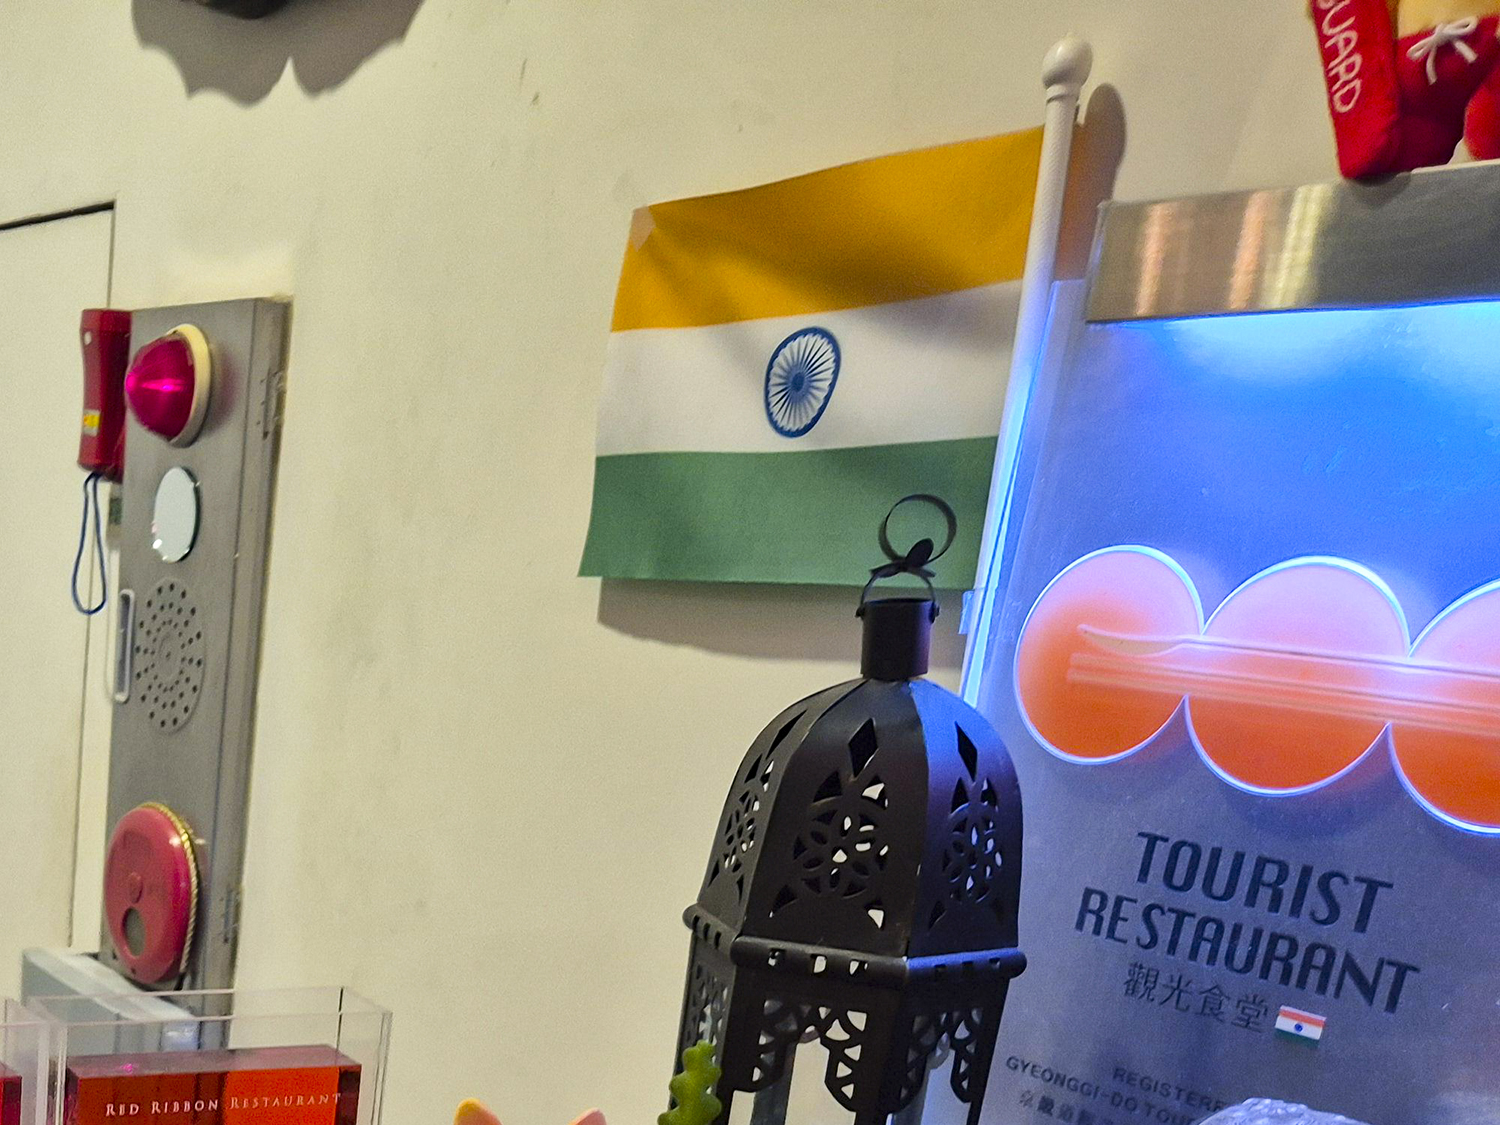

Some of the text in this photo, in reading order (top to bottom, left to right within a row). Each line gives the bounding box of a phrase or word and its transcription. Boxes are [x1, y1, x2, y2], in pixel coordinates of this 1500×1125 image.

[1315, 0, 1363, 113] UARD
[1136, 832, 1394, 933] TOURIST
[1074, 886, 1420, 1014] RESTAURANT
[1123, 961, 1268, 1034] 觀光食堂
[105, 1092, 342, 1117] RED RIBBON RESTAURANT
[1006, 1056, 1138, 1112] GYEONGGI-DO
